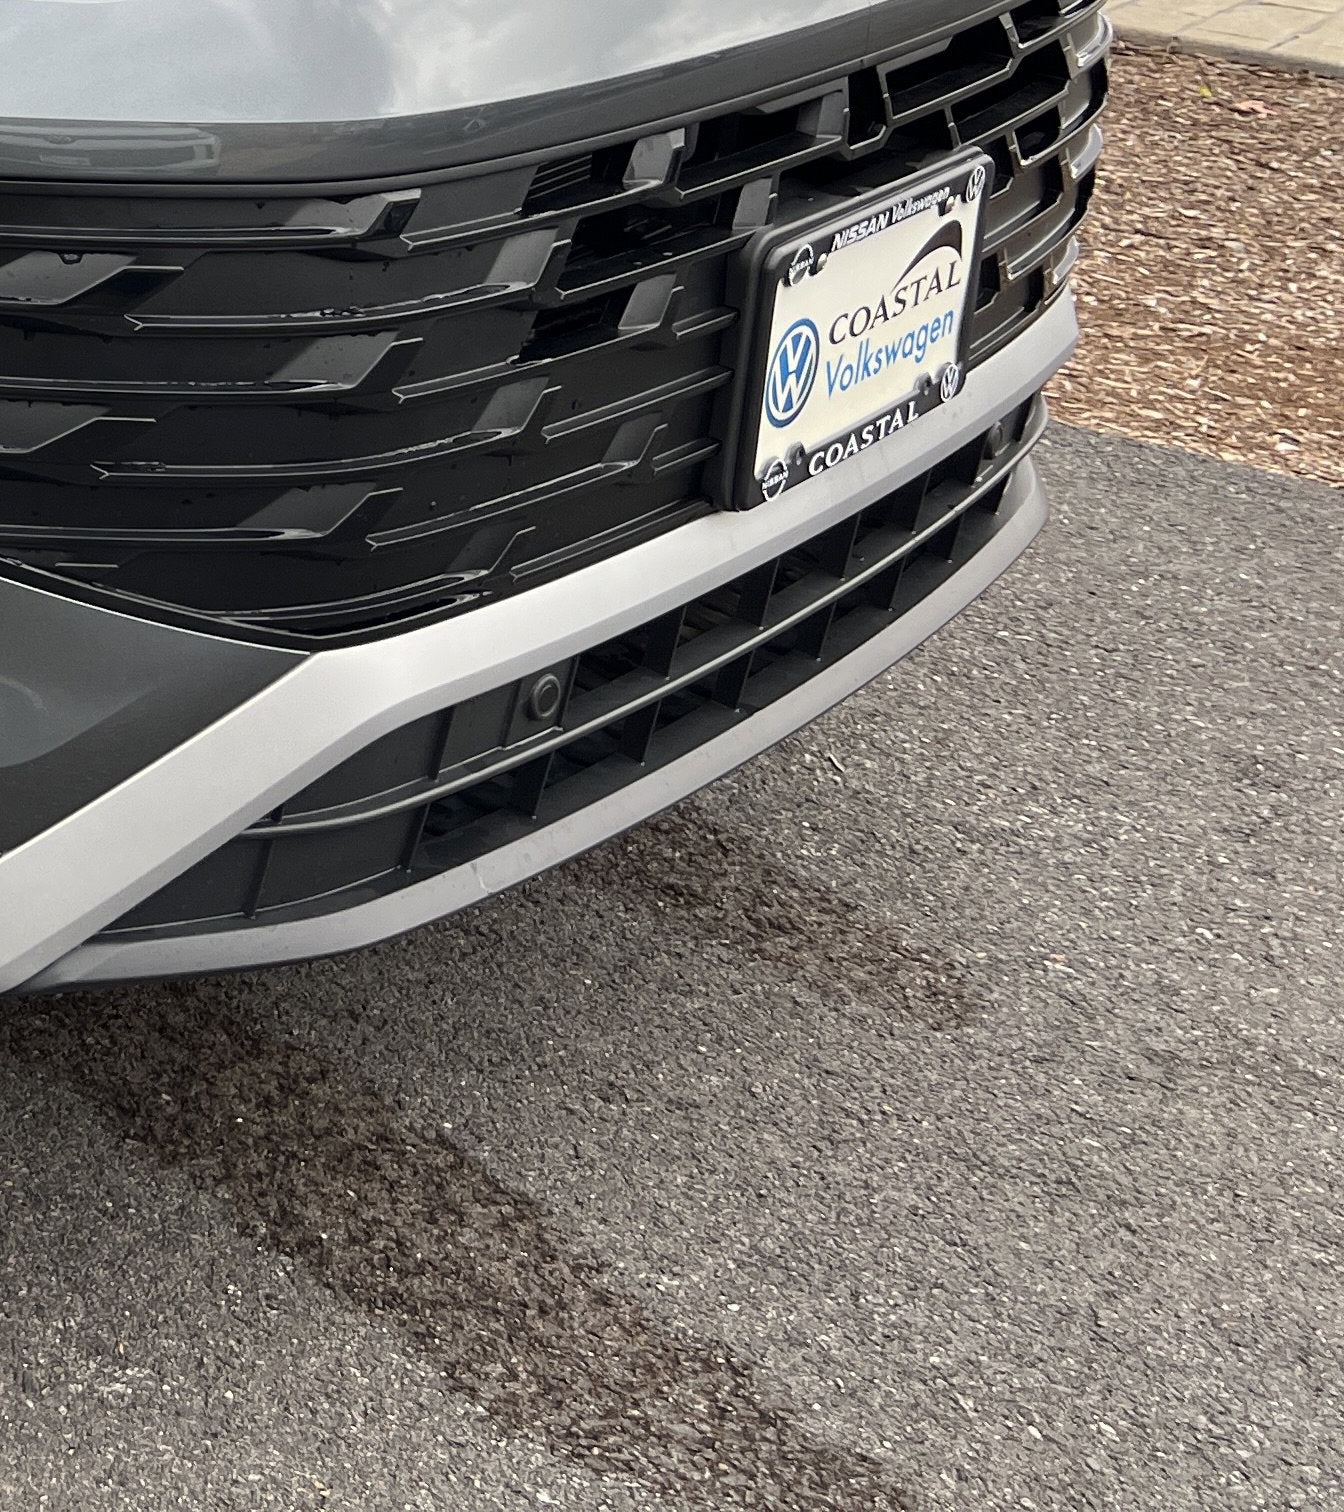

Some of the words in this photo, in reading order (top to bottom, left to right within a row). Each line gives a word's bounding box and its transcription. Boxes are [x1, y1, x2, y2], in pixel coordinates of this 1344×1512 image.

[831, 210, 890, 253] NISSAN
[891, 186, 951, 225] Volkswagen
[828, 258, 962, 346] COASTAL
[765, 318, 820, 428] VW
[825, 309, 955, 399] Volkswagen
[808, 401, 919, 477] COASTAL
